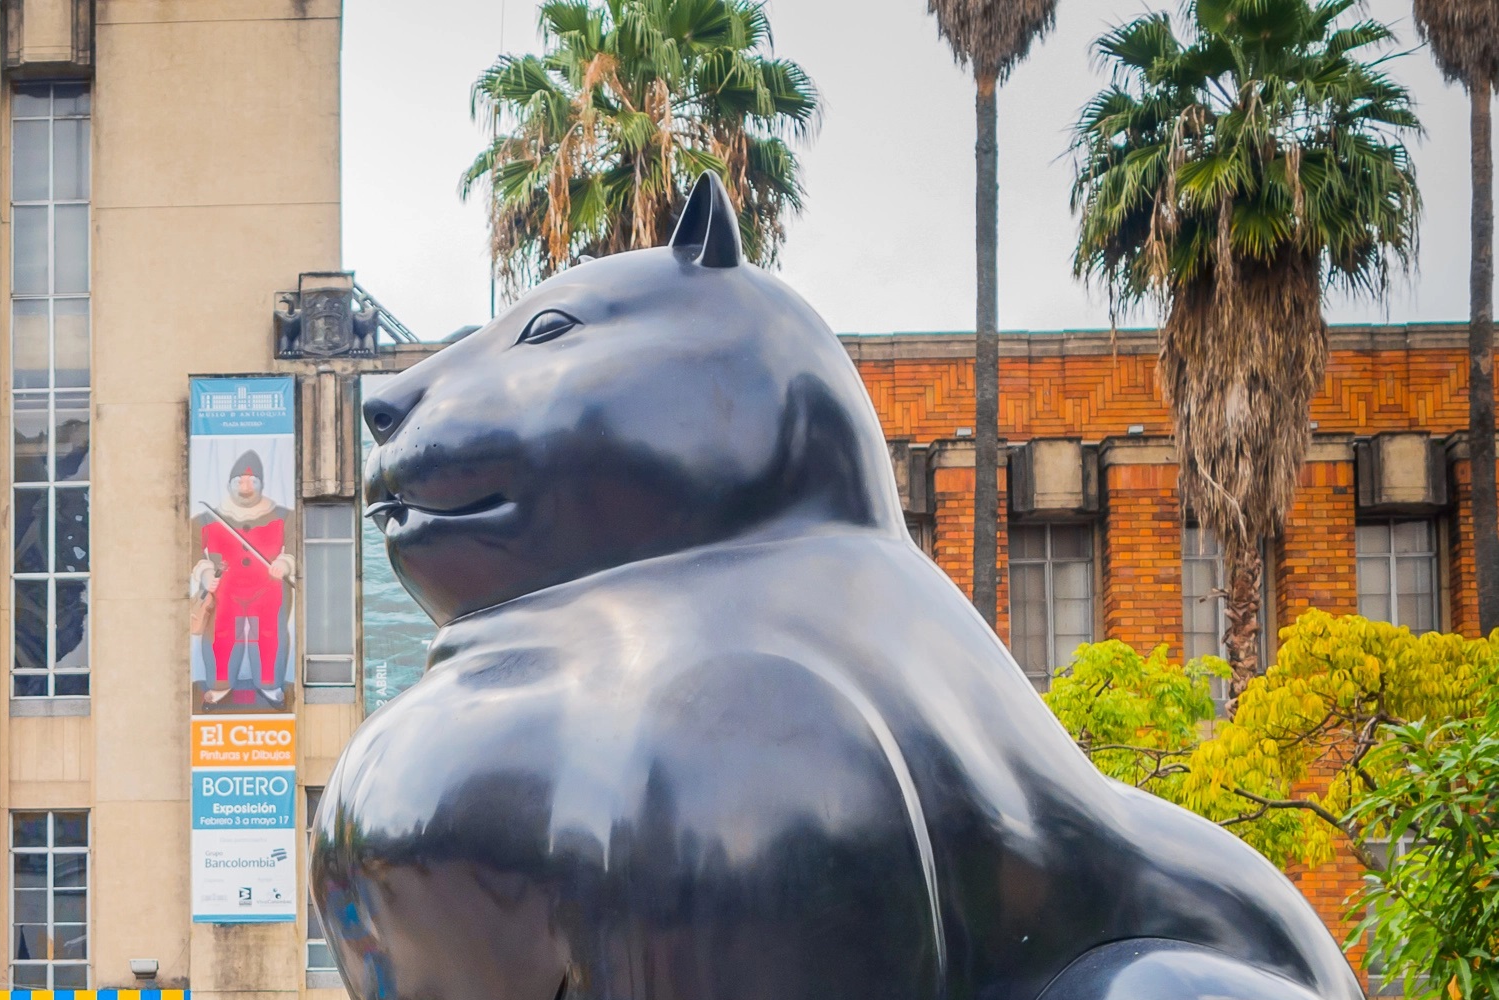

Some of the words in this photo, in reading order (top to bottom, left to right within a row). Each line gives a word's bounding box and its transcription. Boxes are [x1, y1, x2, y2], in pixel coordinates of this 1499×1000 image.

[376, 662, 387, 696] ABRIL
[200, 724, 224, 746] El
[229, 723, 291, 746] Circo
[200, 750, 240, 761] Pinturas
[252, 750, 290, 762] Dibujos
[202, 776, 288, 796] BOTERO
[213, 802, 276, 815] Exposición
[200, 816, 233, 825] Febrero
[251, 818, 276, 827] mayo
[279, 816, 289, 825] 17
[205, 857, 276, 868] Bancolombia
